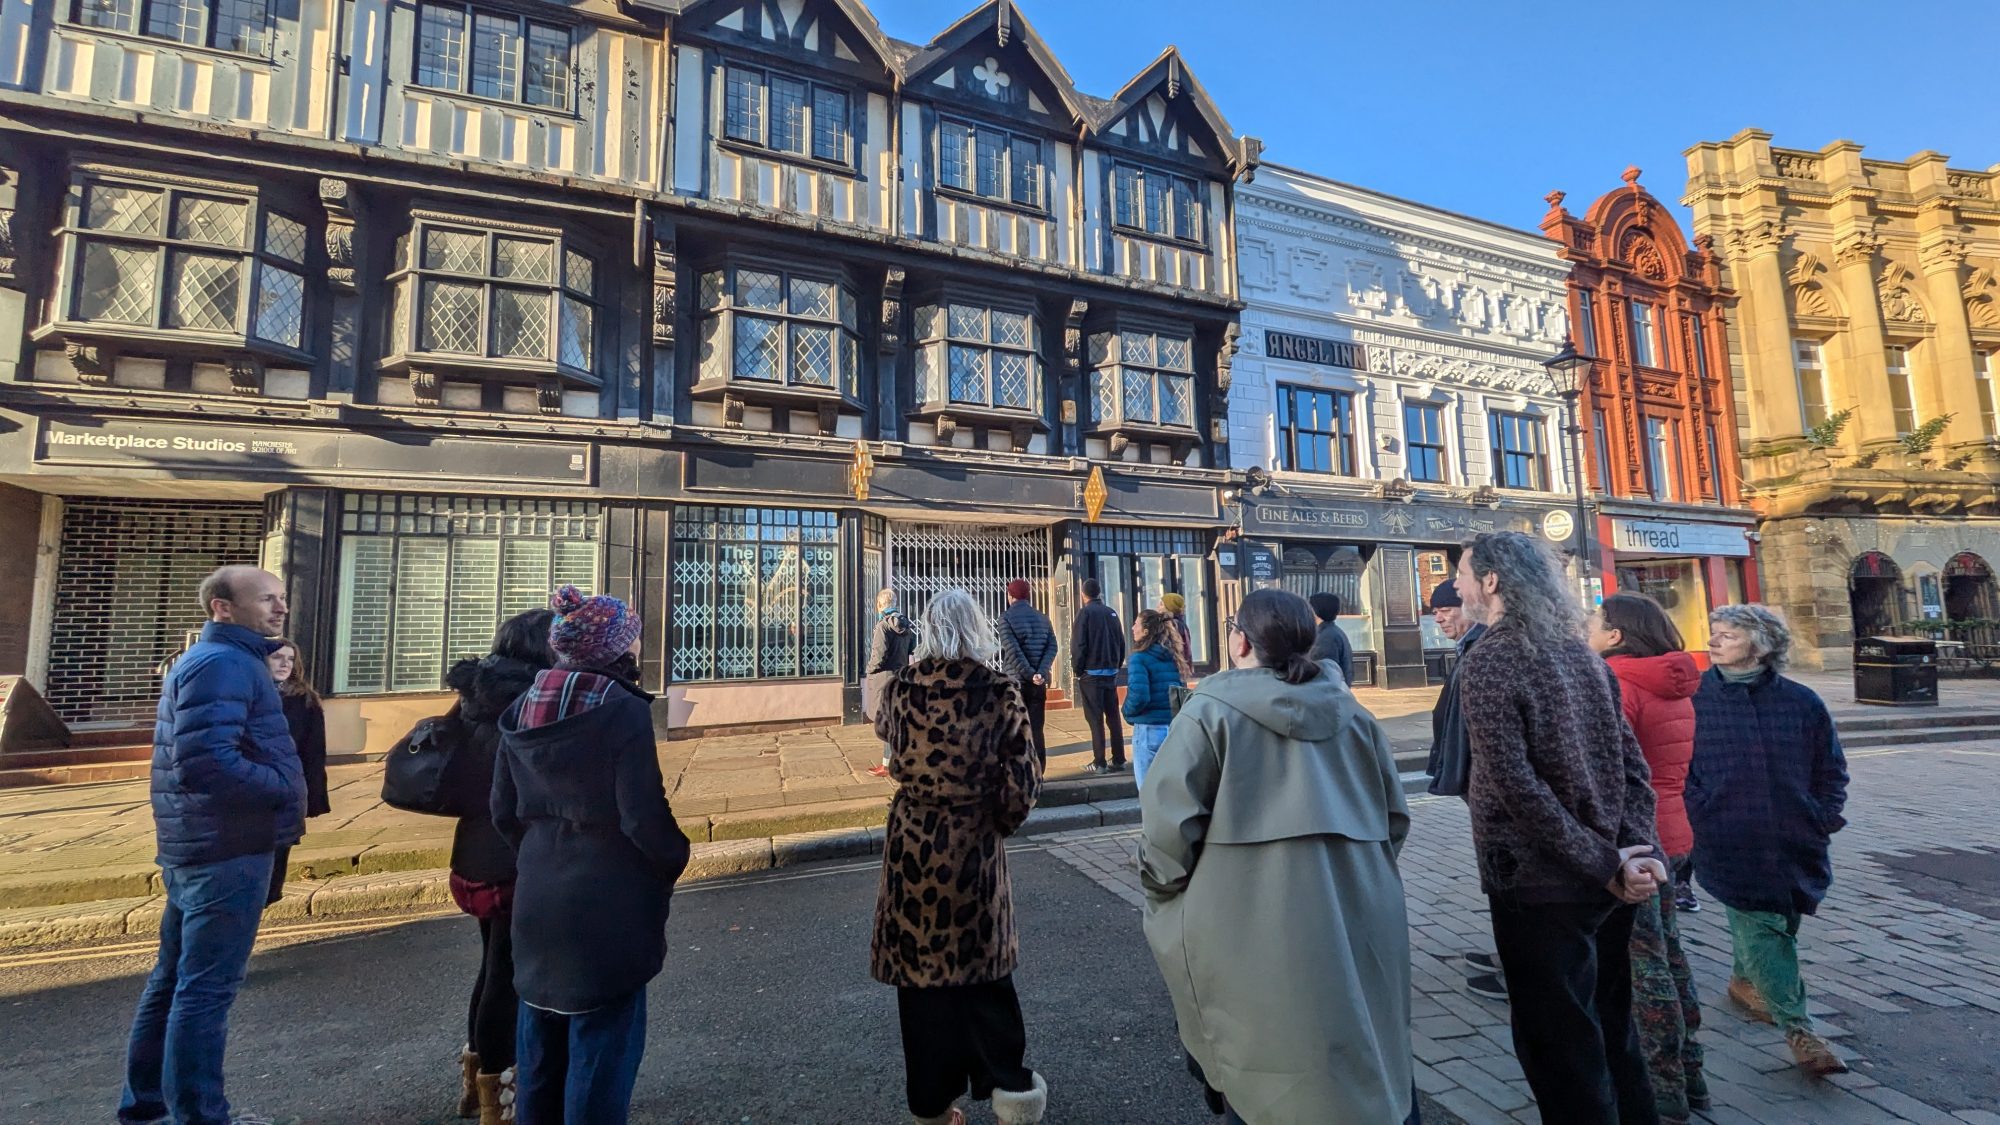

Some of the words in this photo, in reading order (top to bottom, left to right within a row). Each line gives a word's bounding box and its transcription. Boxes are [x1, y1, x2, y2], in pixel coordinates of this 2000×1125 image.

[1269, 333, 1329, 363] ANGEL
[1333, 342, 1367, 371] INN
[46, 431, 168, 449] Marketplace
[173, 436, 246, 452] Studios
[1262, 508, 1289, 521] FINE
[1292, 510, 1318, 522] ALES
[1321, 512, 1330, 523] &
[1333, 512, 1363, 525] BEERS
[1626, 524, 1680, 548] thread
[721, 545, 754, 560] The
[817, 550, 833, 561] to
